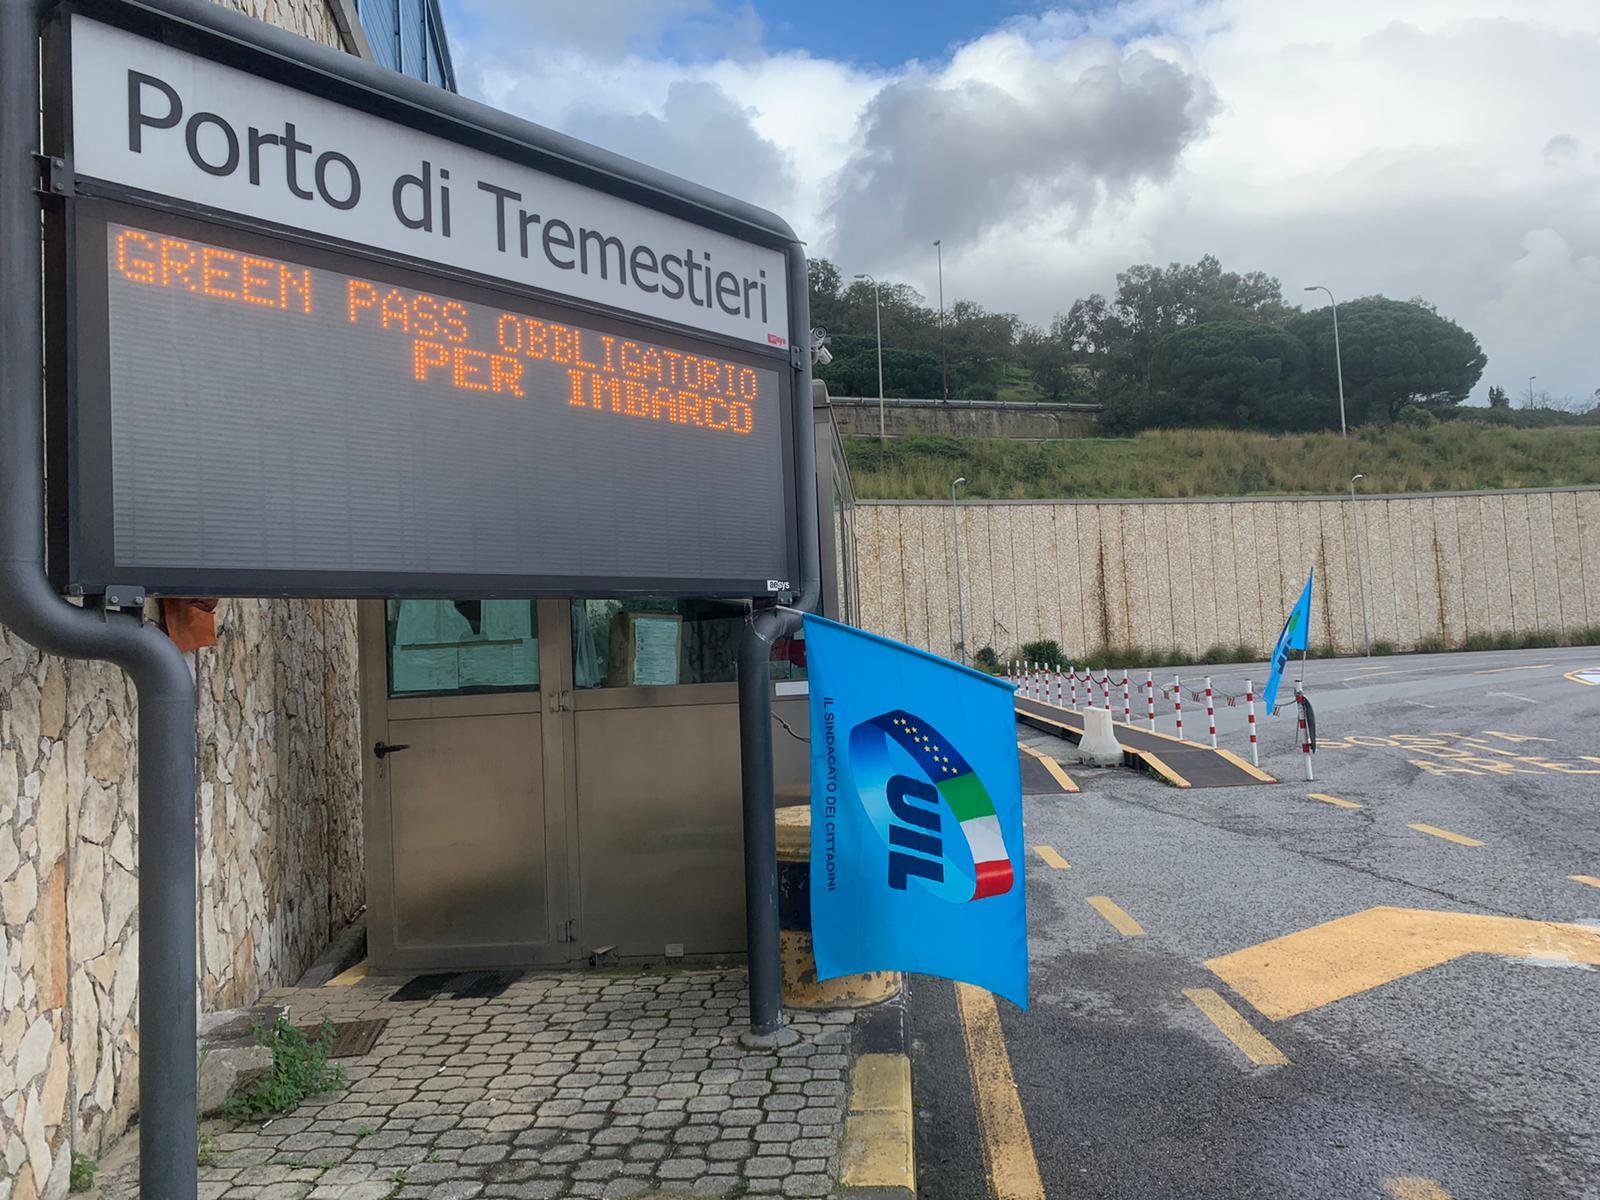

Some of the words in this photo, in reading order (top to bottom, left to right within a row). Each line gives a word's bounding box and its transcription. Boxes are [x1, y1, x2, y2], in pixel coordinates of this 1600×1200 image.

[127, 68, 361, 211] Porto
[392, 160, 451, 238] di
[477, 180, 769, 324] Tremestieri
[115, 230, 312, 314] GREEN
[348, 279, 470, 343] PASS
[498, 313, 758, 401] OBBLIGATORIO
[412, 340, 526, 398] PER
[568, 368, 755, 435] IMBARCO
[823, 697, 834, 709] IL
[823, 712, 837, 793] SINDACATO
[825, 796, 836, 818] DEI
[886, 774, 945, 891] UIL
[825, 822, 836, 892] CITTADINI
